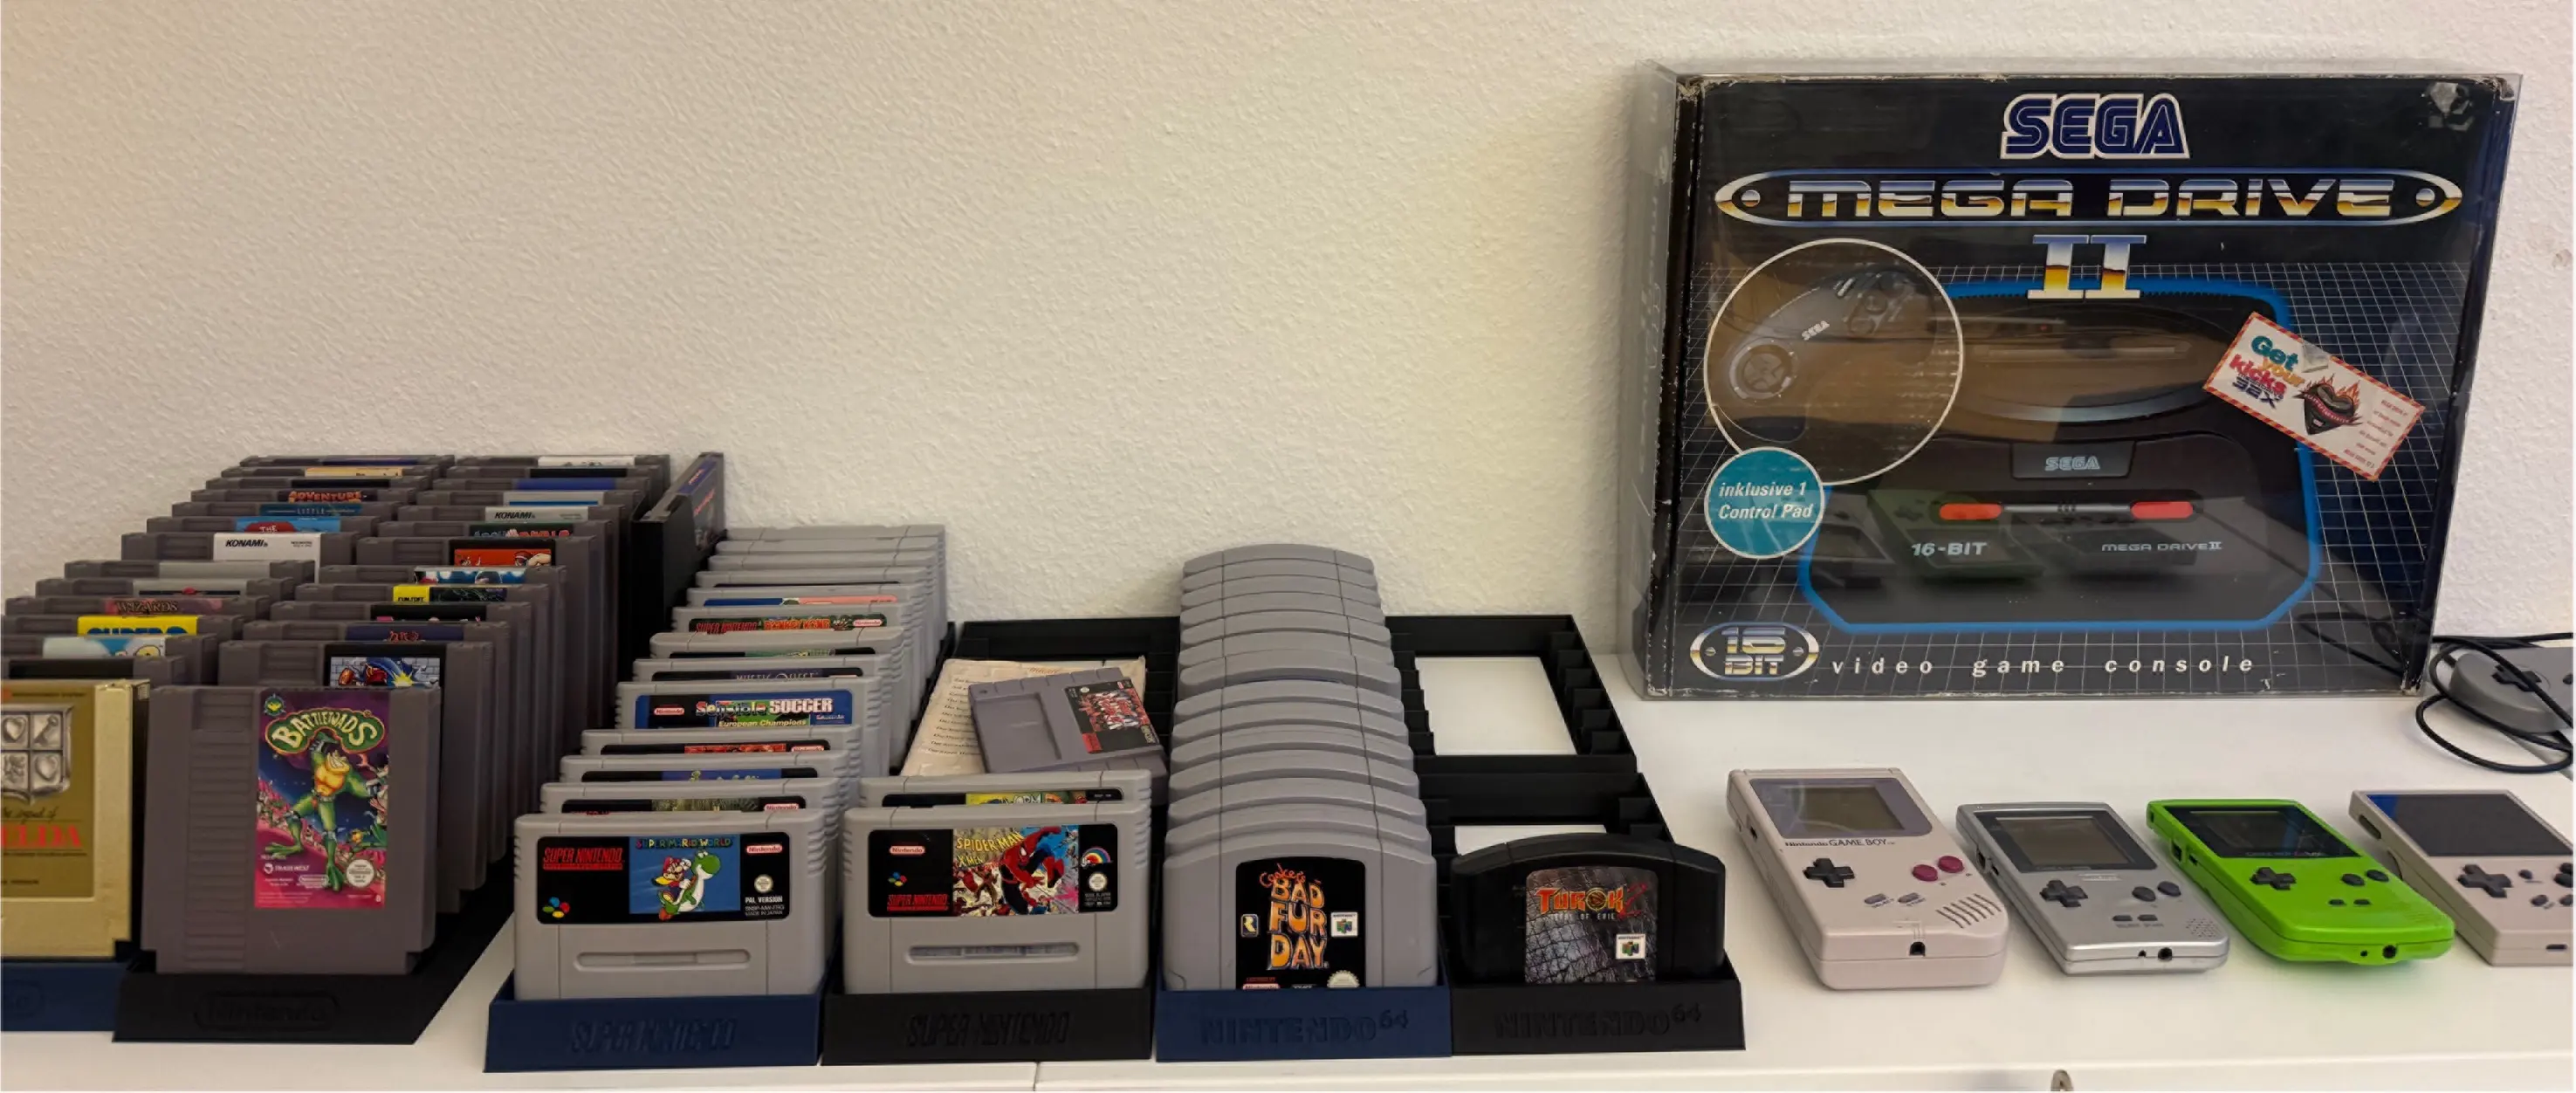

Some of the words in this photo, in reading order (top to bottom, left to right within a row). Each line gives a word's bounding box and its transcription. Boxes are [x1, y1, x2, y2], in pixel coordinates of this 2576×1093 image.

[2000, 93, 2190, 160] SEGA
[1788, 179, 2073, 217] MEGA
[2106, 178, 2394, 217] DRIVE
[2027, 234, 2147, 299] II
[1802, 320, 1831, 341] SEGA
[2251, 335, 2298, 372] Get
[2229, 354, 2287, 395] kicks
[2257, 356, 2305, 387] your
[2044, 456, 2100, 471] SEGA
[289, 491, 361, 500] ADVENTURE
[1719, 481, 1793, 497] inklusive
[1798, 482, 1807, 496] 1
[1718, 504, 1777, 519] Control
[1781, 504, 1814, 519] Pad
[225, 539, 264, 547] KONAMI
[1912, 541, 1988, 557] 16-BIT
[2102, 543, 2152, 552] MEGA
[116, 601, 179, 612] WIZARDS
[764, 621, 801, 629] DONKEY
[802, 619, 831, 629] KONG
[1724, 655, 1784, 675] BIT
[1832, 655, 1933, 674] video
[1972, 656, 2064, 677] game
[2105, 656, 2253, 674] console
[769, 698, 834, 713] SOCCER
[2, 825, 82, 848] ELDA
[543, 848, 574, 863] SUPER
[575, 847, 622, 863] NINTENDO
[890, 846, 924, 855] Nintendo
[887, 894, 911, 906] SUPER
[912, 894, 949, 906] NINTENDO
[1271, 877, 1325, 909] BAD
[1270, 901, 1328, 937] FUR
